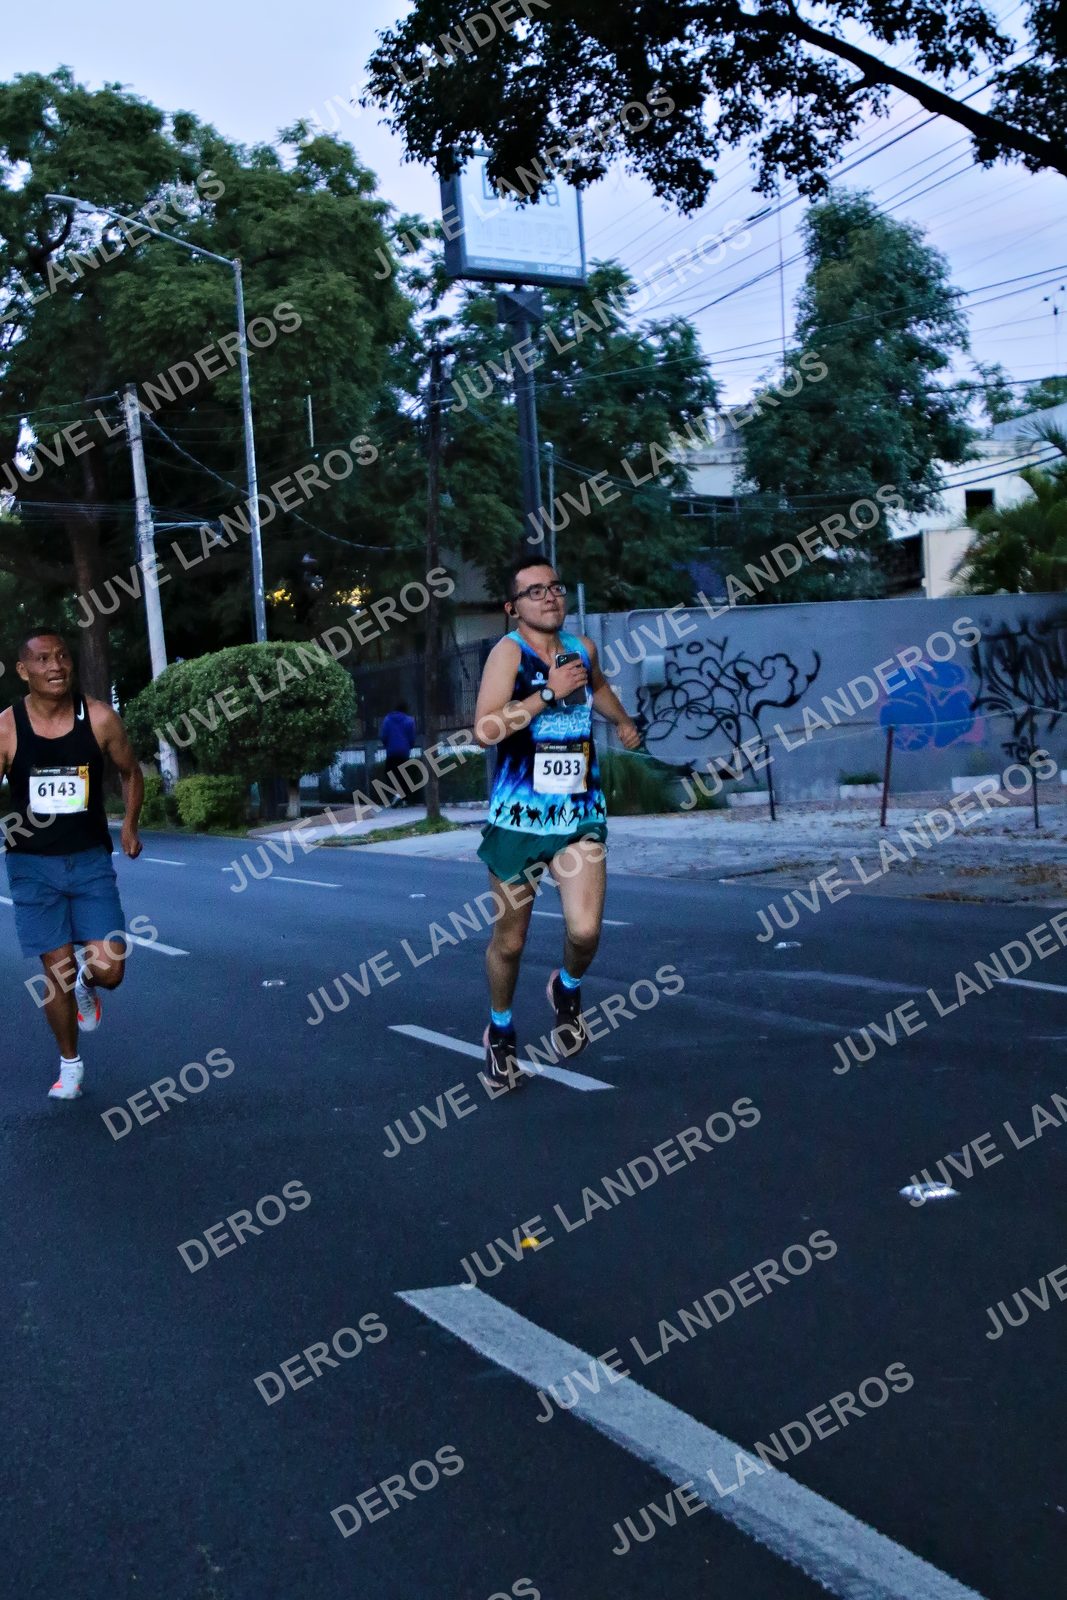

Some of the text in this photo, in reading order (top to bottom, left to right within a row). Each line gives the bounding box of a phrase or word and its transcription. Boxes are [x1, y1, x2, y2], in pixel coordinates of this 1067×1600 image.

[665, 636, 729, 662] TOY
[543, 760, 581, 776] 5033
[38, 782, 76, 797] 6143
